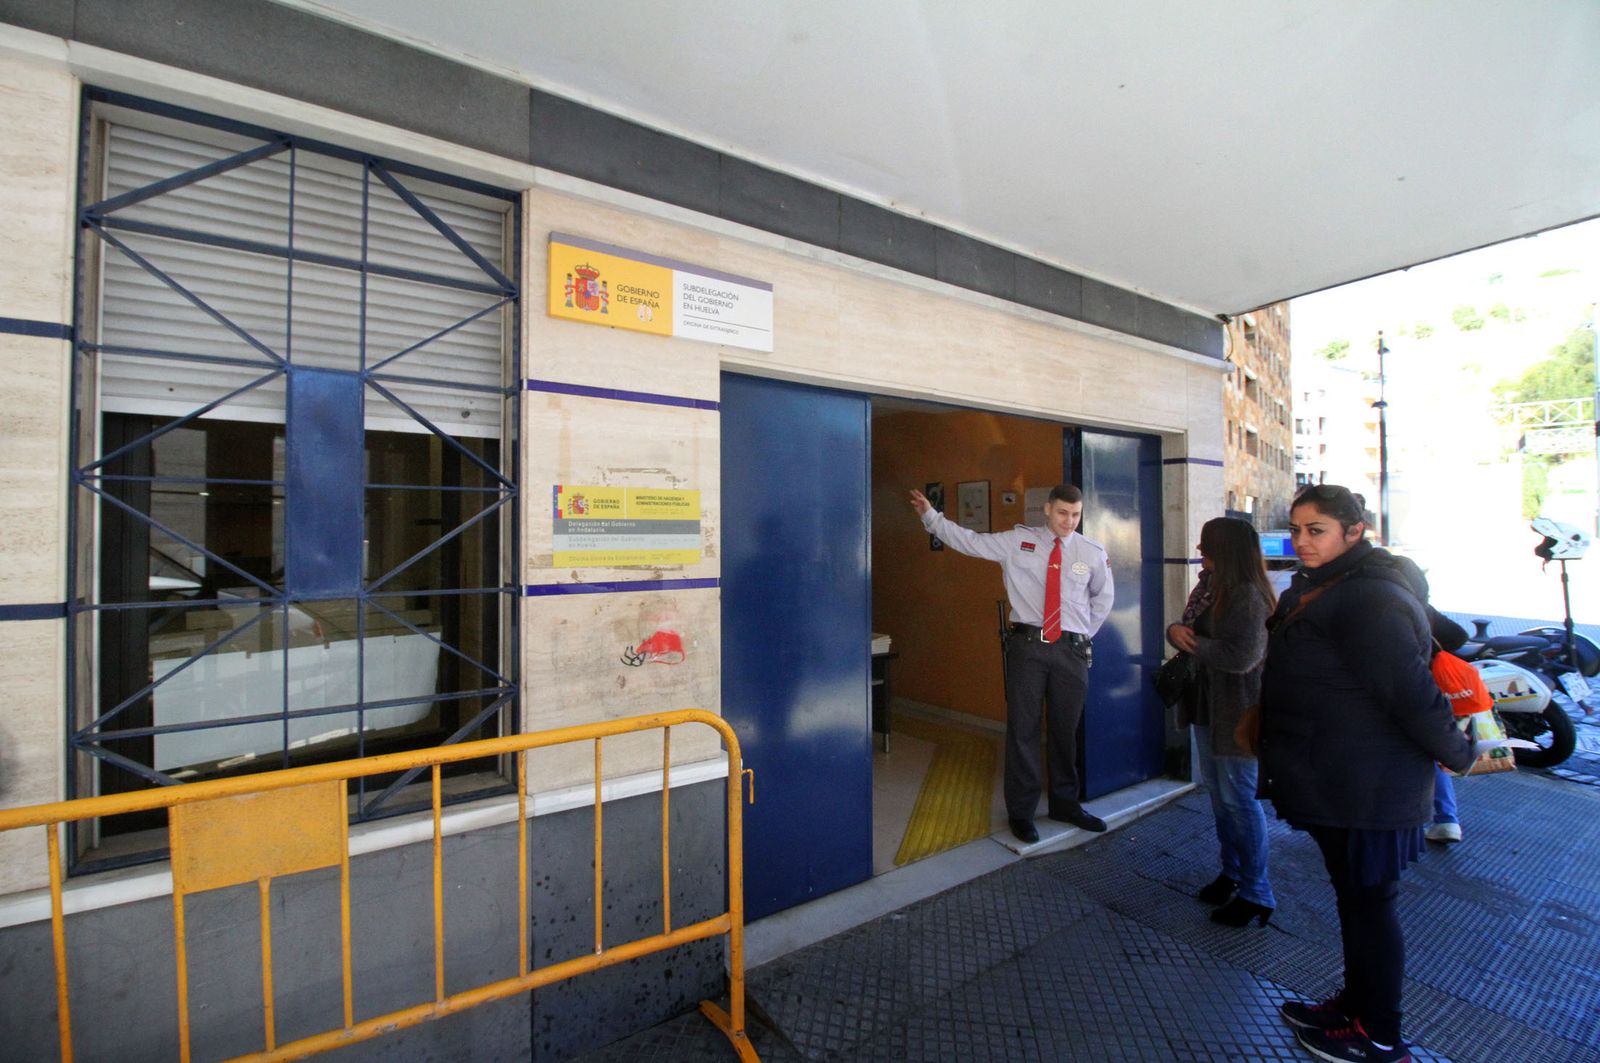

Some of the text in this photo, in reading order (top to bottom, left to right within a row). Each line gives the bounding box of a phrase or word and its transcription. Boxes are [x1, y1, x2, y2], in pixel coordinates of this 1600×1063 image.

[617, 284, 660, 299] GOBIERNO
[683, 283, 739, 301] SUBDELEGACIÓN
[617, 294, 660, 310] DE ESPAÑA
[683, 293, 734, 310] DEL GOBIERNO
[683, 302, 720, 316] EN HUELVA
